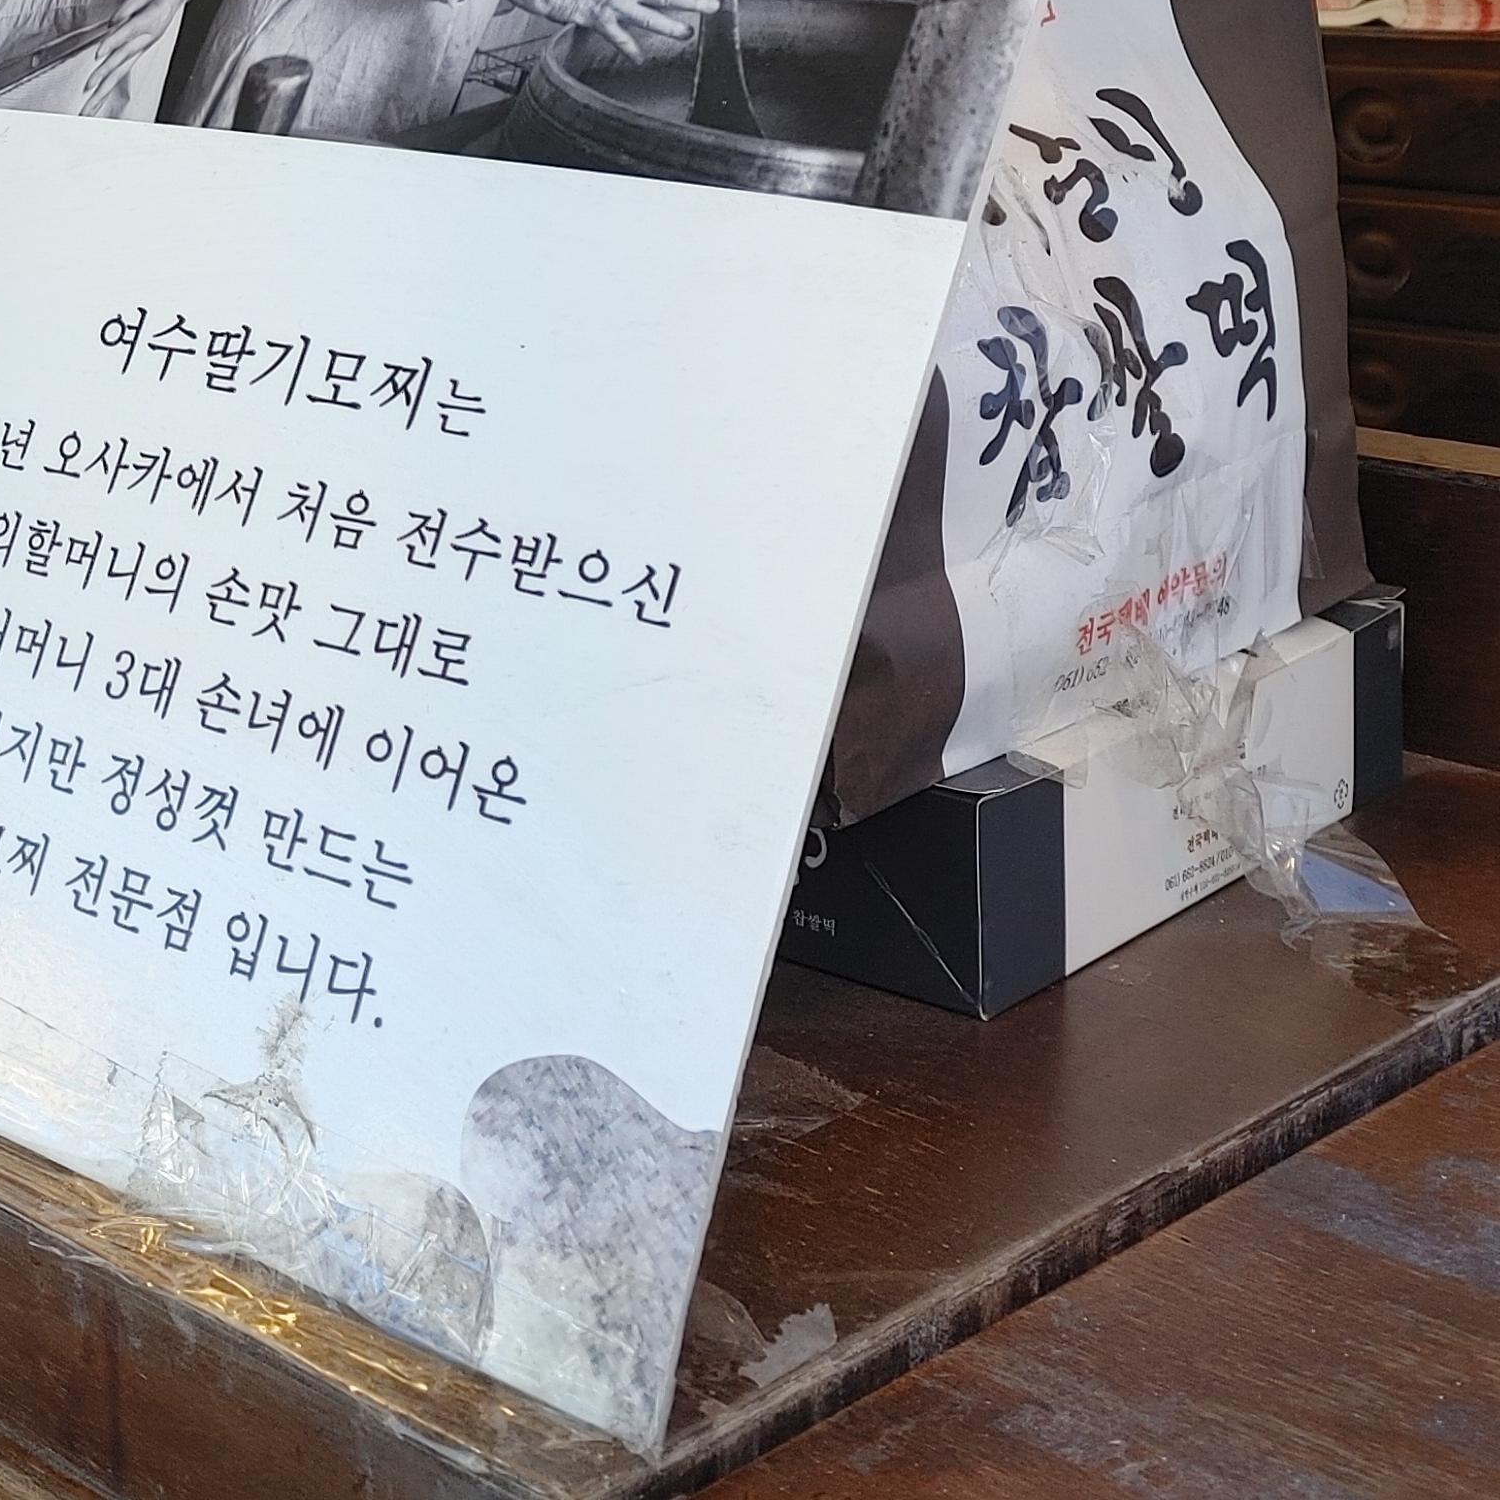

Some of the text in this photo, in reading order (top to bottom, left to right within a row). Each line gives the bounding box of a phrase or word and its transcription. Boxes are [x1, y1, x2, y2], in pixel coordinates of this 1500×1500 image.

[100, 306, 487, 438] 여수딸기모찌는
[43, 430, 265, 528] 오사카에서
[276, 480, 377, 551] 처음
[396, 508, 682, 629] 전수받으신
[204, 566, 302, 643] 손맛
[313, 603, 472, 687] 그대로
[105, 650, 183, 720] 3대
[196, 672, 346, 772] 손녀에
[365, 724, 528, 826] 이어온
[100, 754, 240, 852] 정성껏
[263, 807, 414, 910] 만드는
[64, 854, 203, 953] 전문점
[225, 910, 385, 1029] 입니다.
